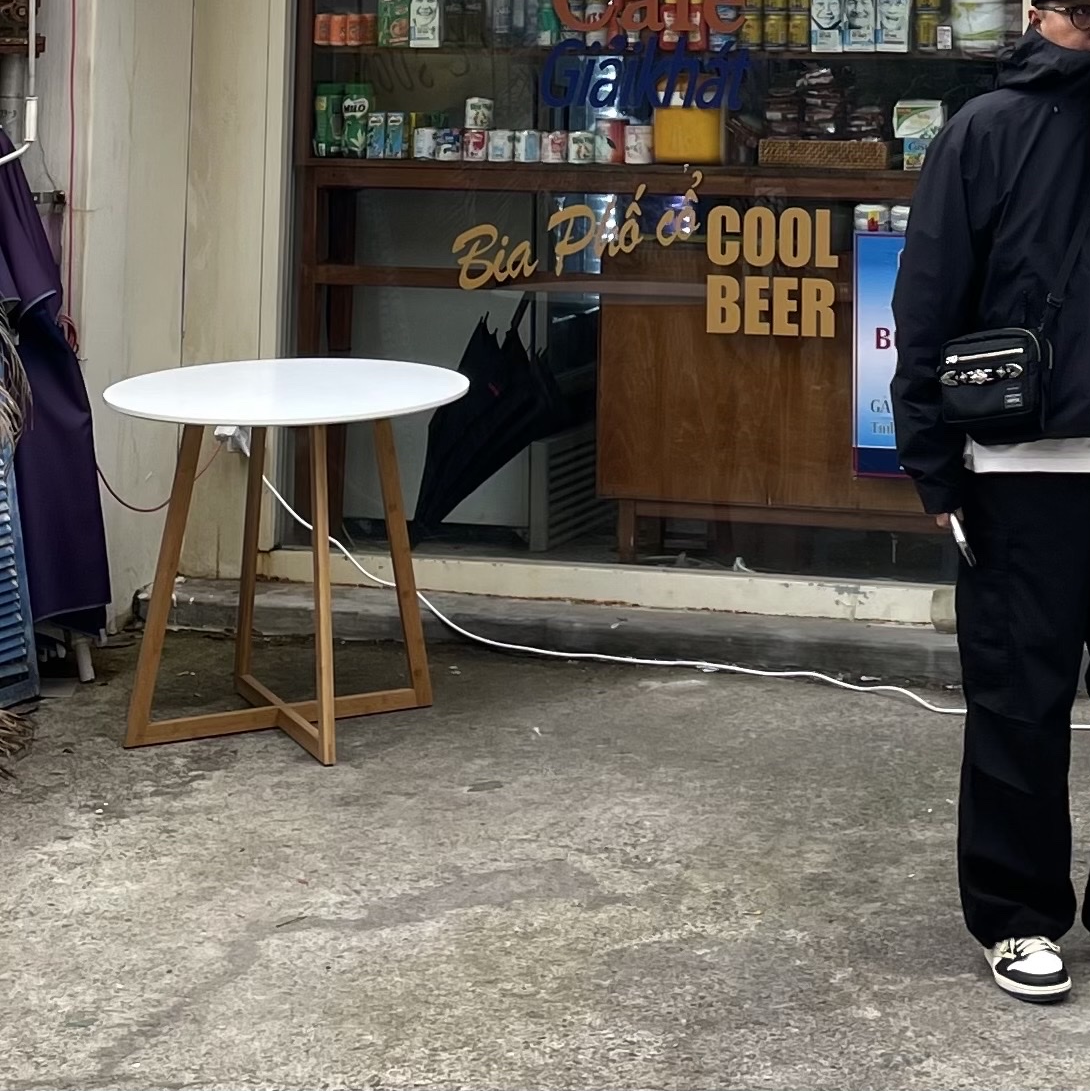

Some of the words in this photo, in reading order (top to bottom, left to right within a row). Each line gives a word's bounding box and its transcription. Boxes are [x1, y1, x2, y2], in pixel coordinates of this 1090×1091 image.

[452, 224, 539, 290] Bia
[547, 184, 646, 276] Phố
[706, 204, 839, 269] COOL
[706, 274, 836, 338] BEER
